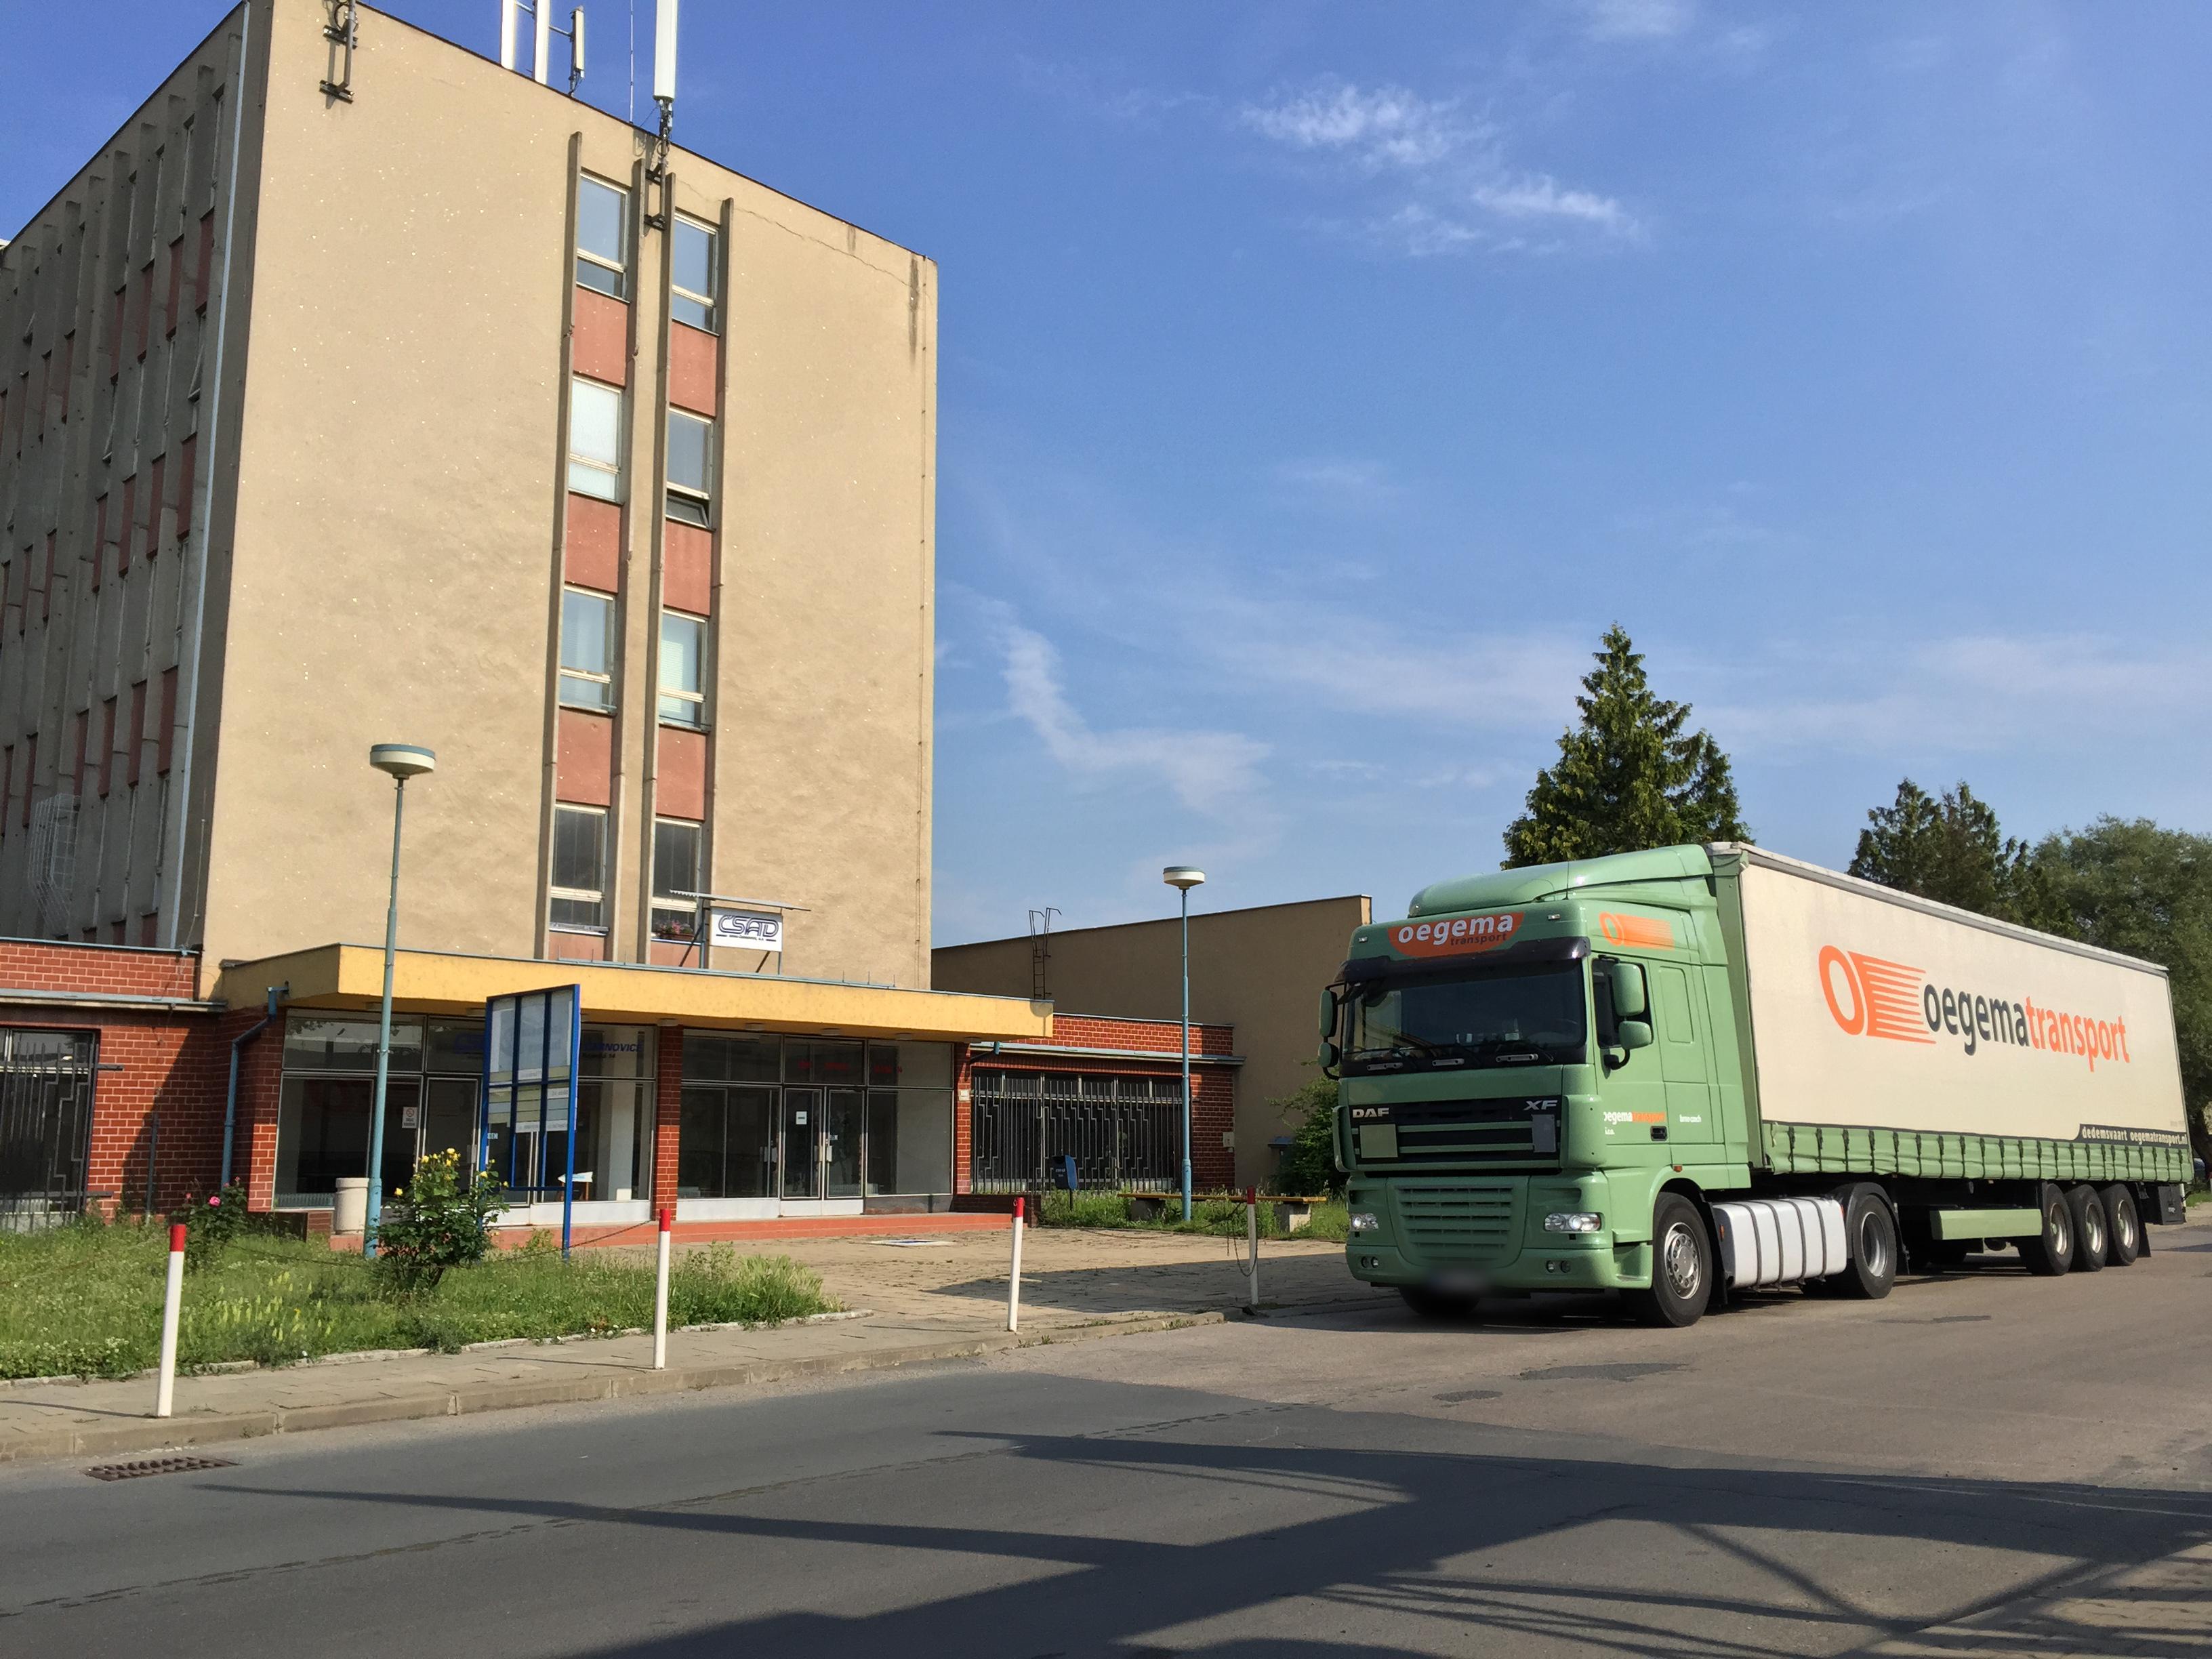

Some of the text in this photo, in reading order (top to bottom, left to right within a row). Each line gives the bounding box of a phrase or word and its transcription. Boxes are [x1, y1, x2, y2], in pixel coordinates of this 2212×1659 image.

[1398, 915, 1513, 945] oegema
[1450, 933, 1507, 946] transport
[1924, 984, 2130, 1072] oegematransport
[1352, 1107, 1389, 1118] DAF
[1524, 1099, 1558, 1111] XF
[2082, 1126, 2188, 1147] dedemsvaart oegematransport.nl
